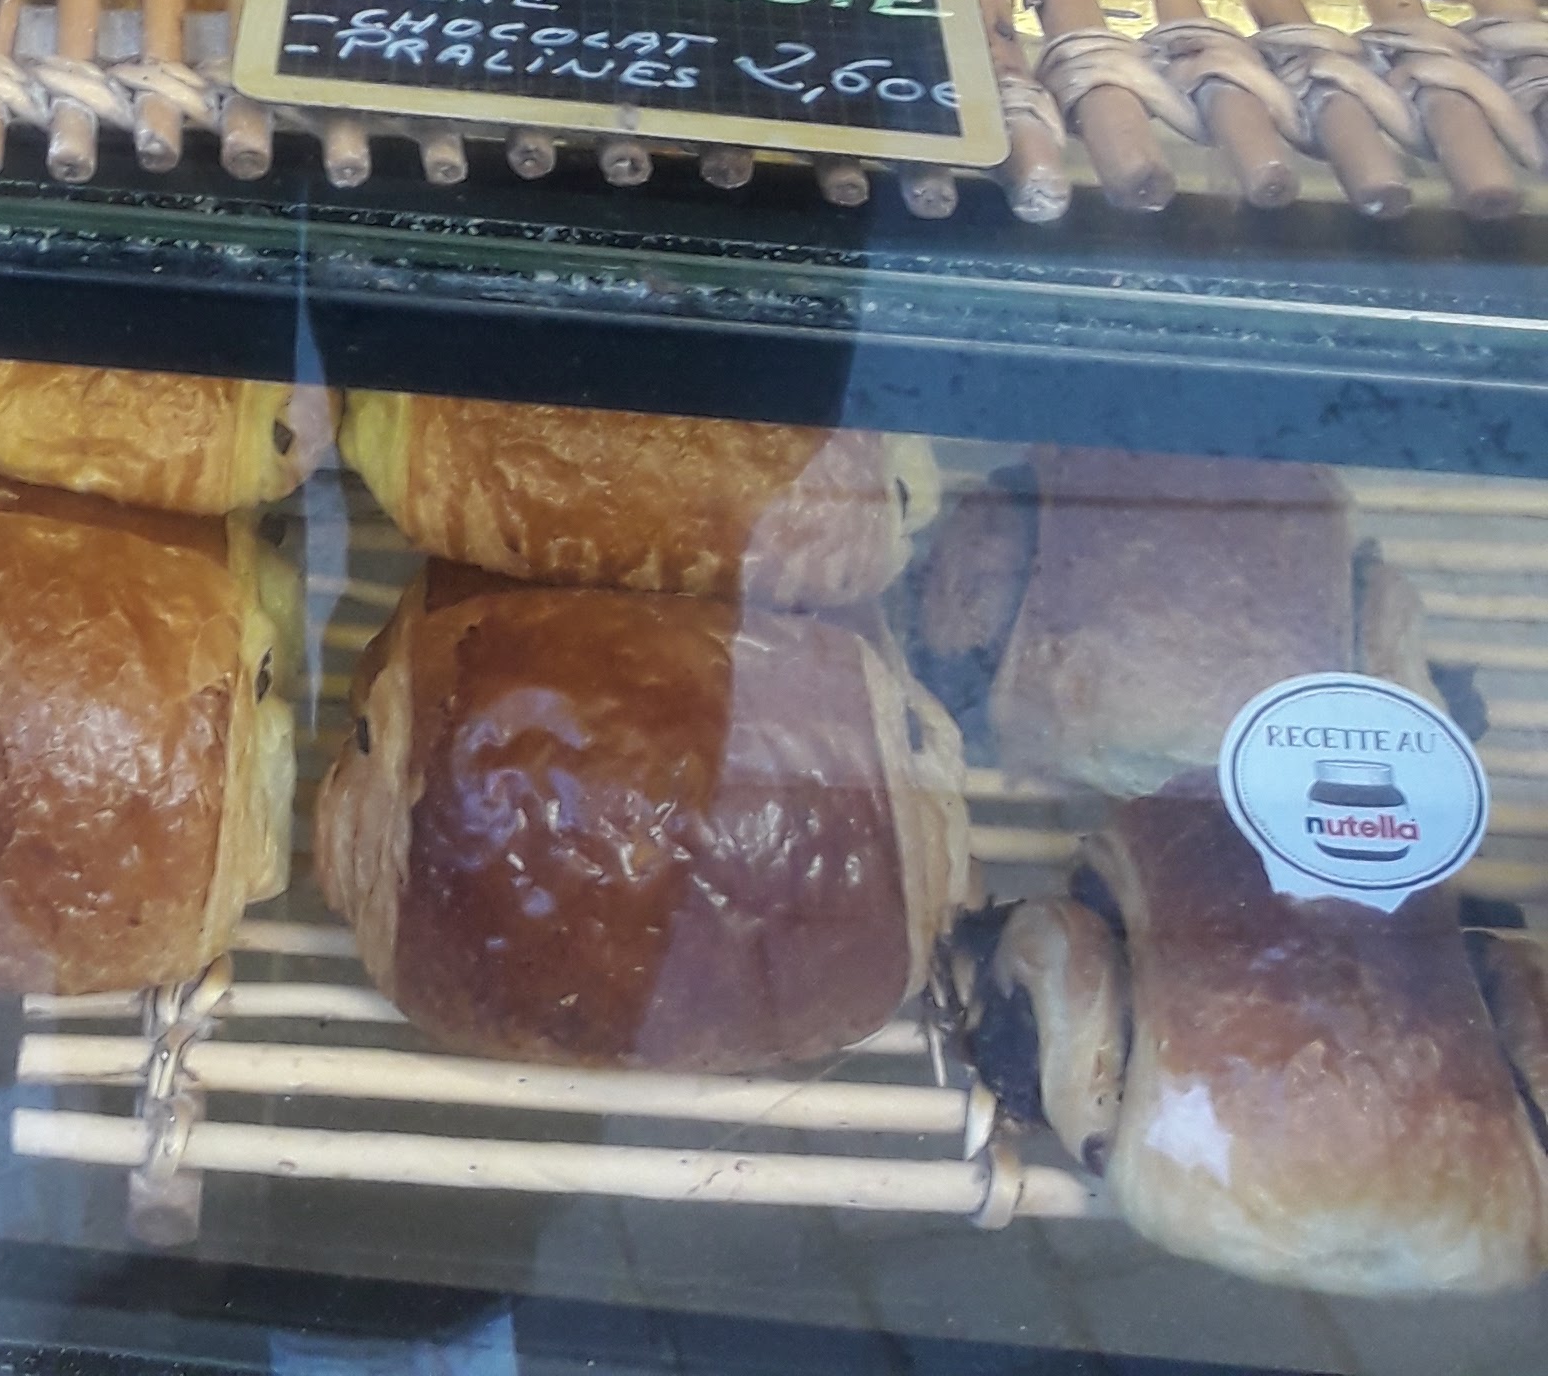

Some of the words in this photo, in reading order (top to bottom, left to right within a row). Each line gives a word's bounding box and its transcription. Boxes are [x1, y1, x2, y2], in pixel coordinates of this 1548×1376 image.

[349, 8, 718, 57] CHOCOLAT
[1266, 725, 1390, 751] RECETTE
[1398, 732, 1436, 753] AU
[1305, 814, 1419, 840] nutella
